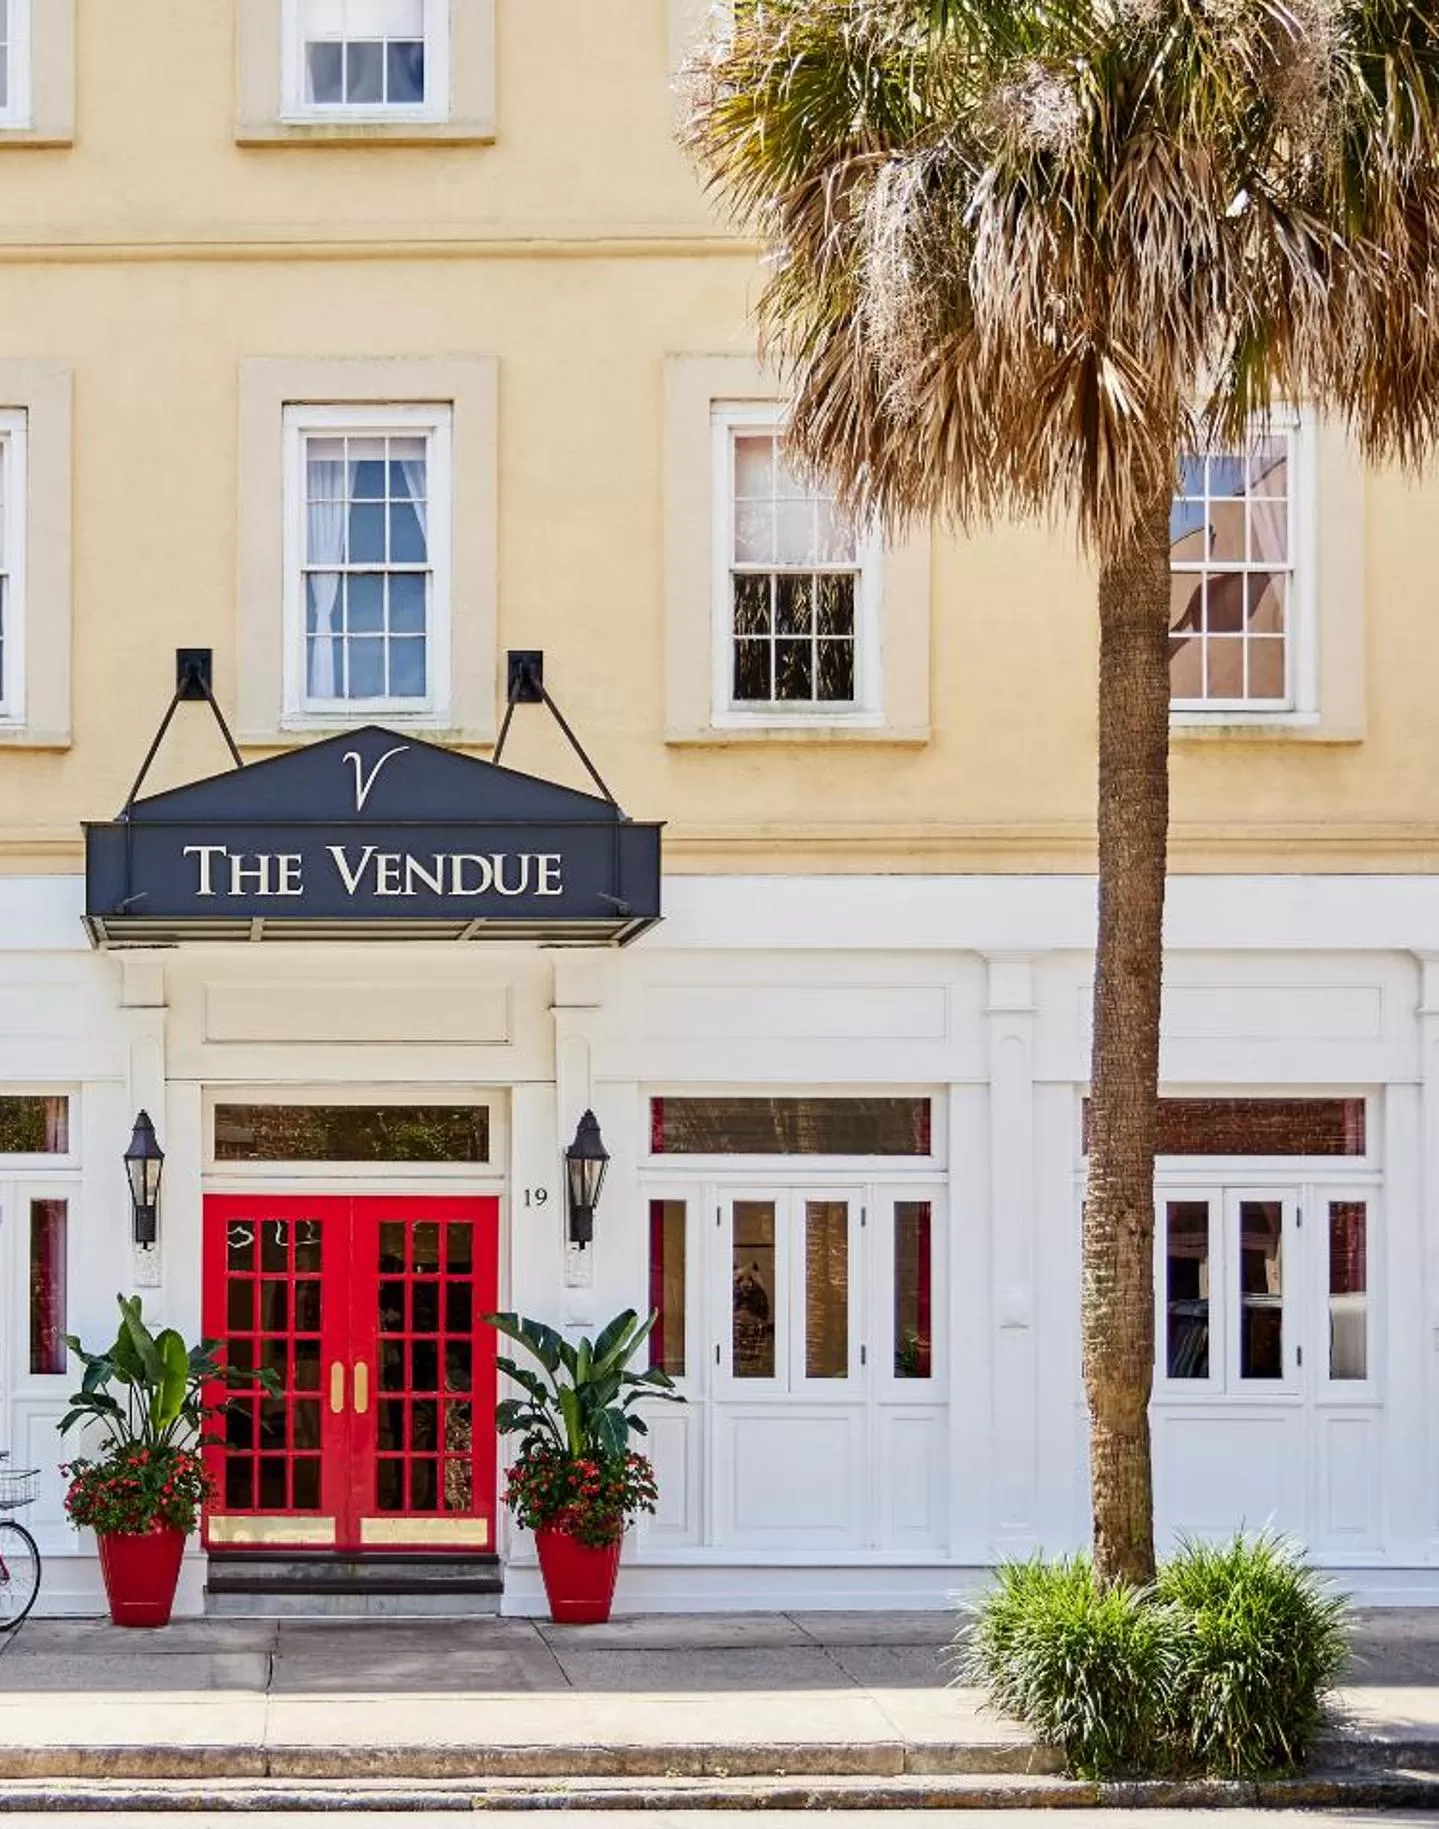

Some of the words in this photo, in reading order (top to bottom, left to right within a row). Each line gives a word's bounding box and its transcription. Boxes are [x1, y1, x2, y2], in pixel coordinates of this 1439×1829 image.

[343, 745, 409, 811] V
[183, 845, 304, 896] THE
[326, 845, 563, 896] VENDUE
[524, 1187, 548, 1207] 19
